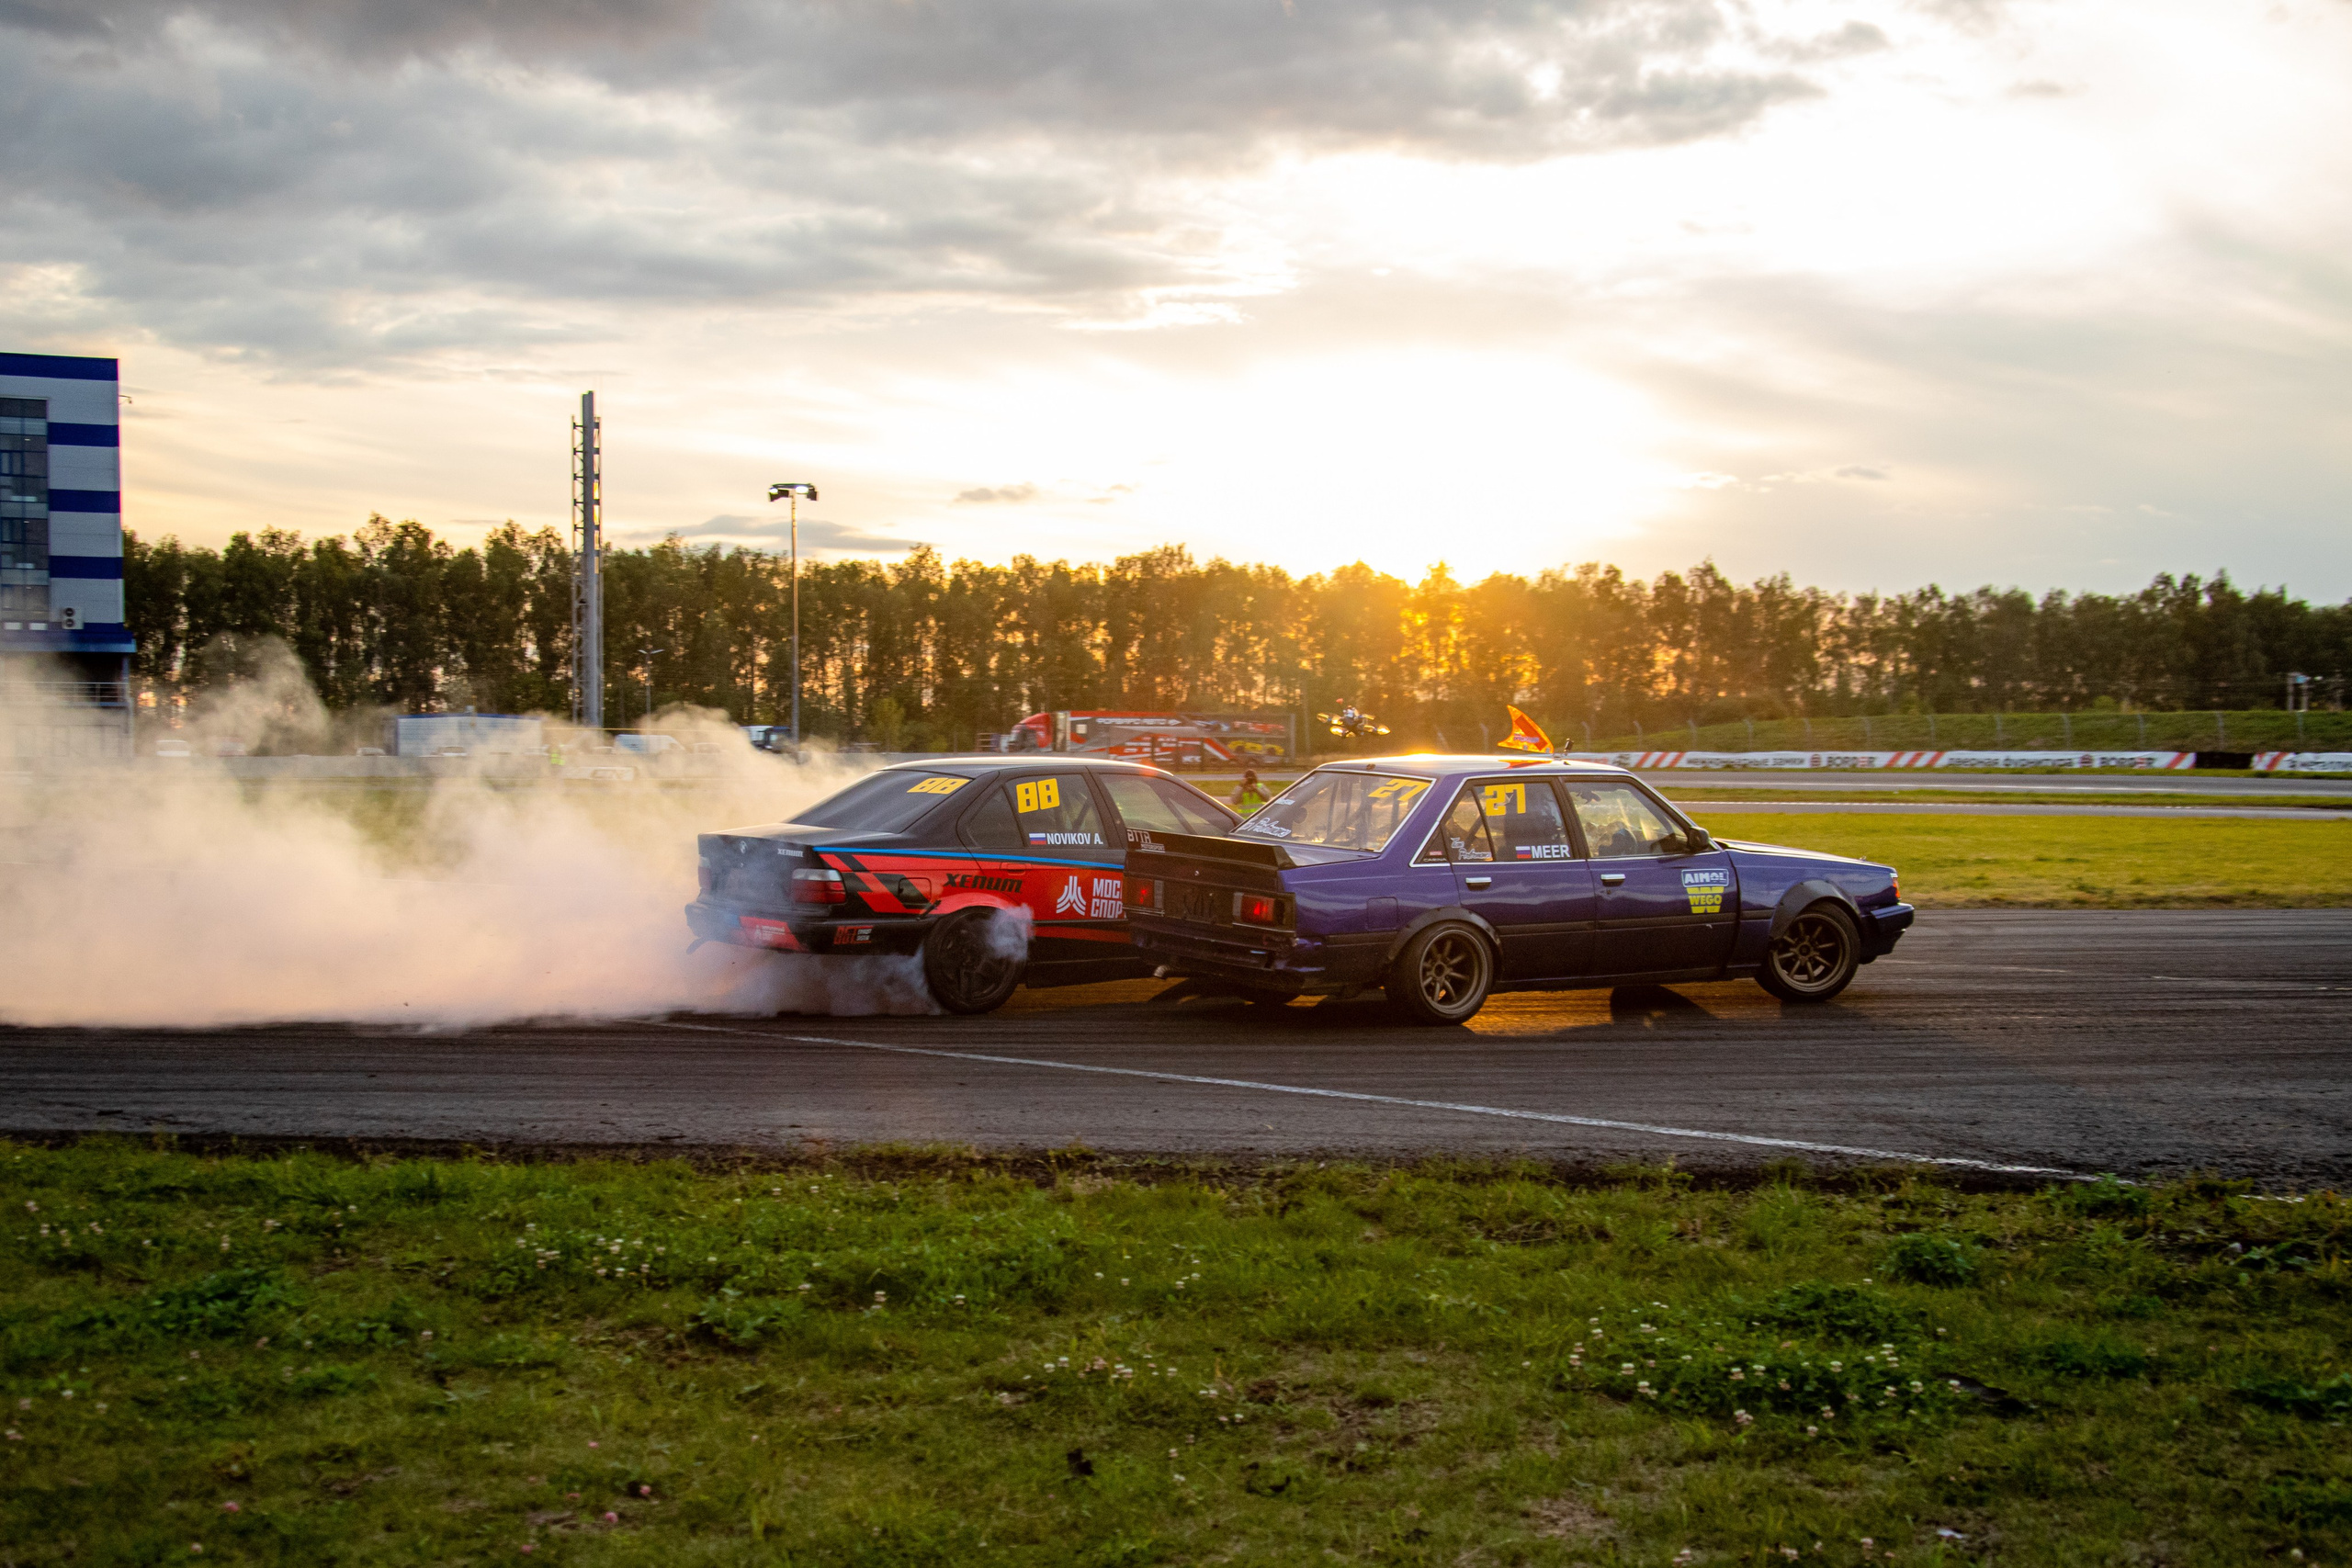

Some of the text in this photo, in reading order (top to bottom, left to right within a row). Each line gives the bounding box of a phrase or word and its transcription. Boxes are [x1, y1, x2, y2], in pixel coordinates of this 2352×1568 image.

[906, 777, 969, 795] 88
[1016, 778, 1060, 814] 88
[1368, 778, 1430, 802] 27
[1485, 783, 1526, 817] 27
[1046, 832, 1103, 845] NOVIKOV A.
[1532, 844, 1570, 859] MEER
[944, 873, 1023, 893] XENUM
[1093, 877, 1122, 899] МОС
[1684, 872, 1727, 884] AIMOL
[1091, 898, 1126, 919] СПОР
[1689, 894, 1723, 906] WEGO
